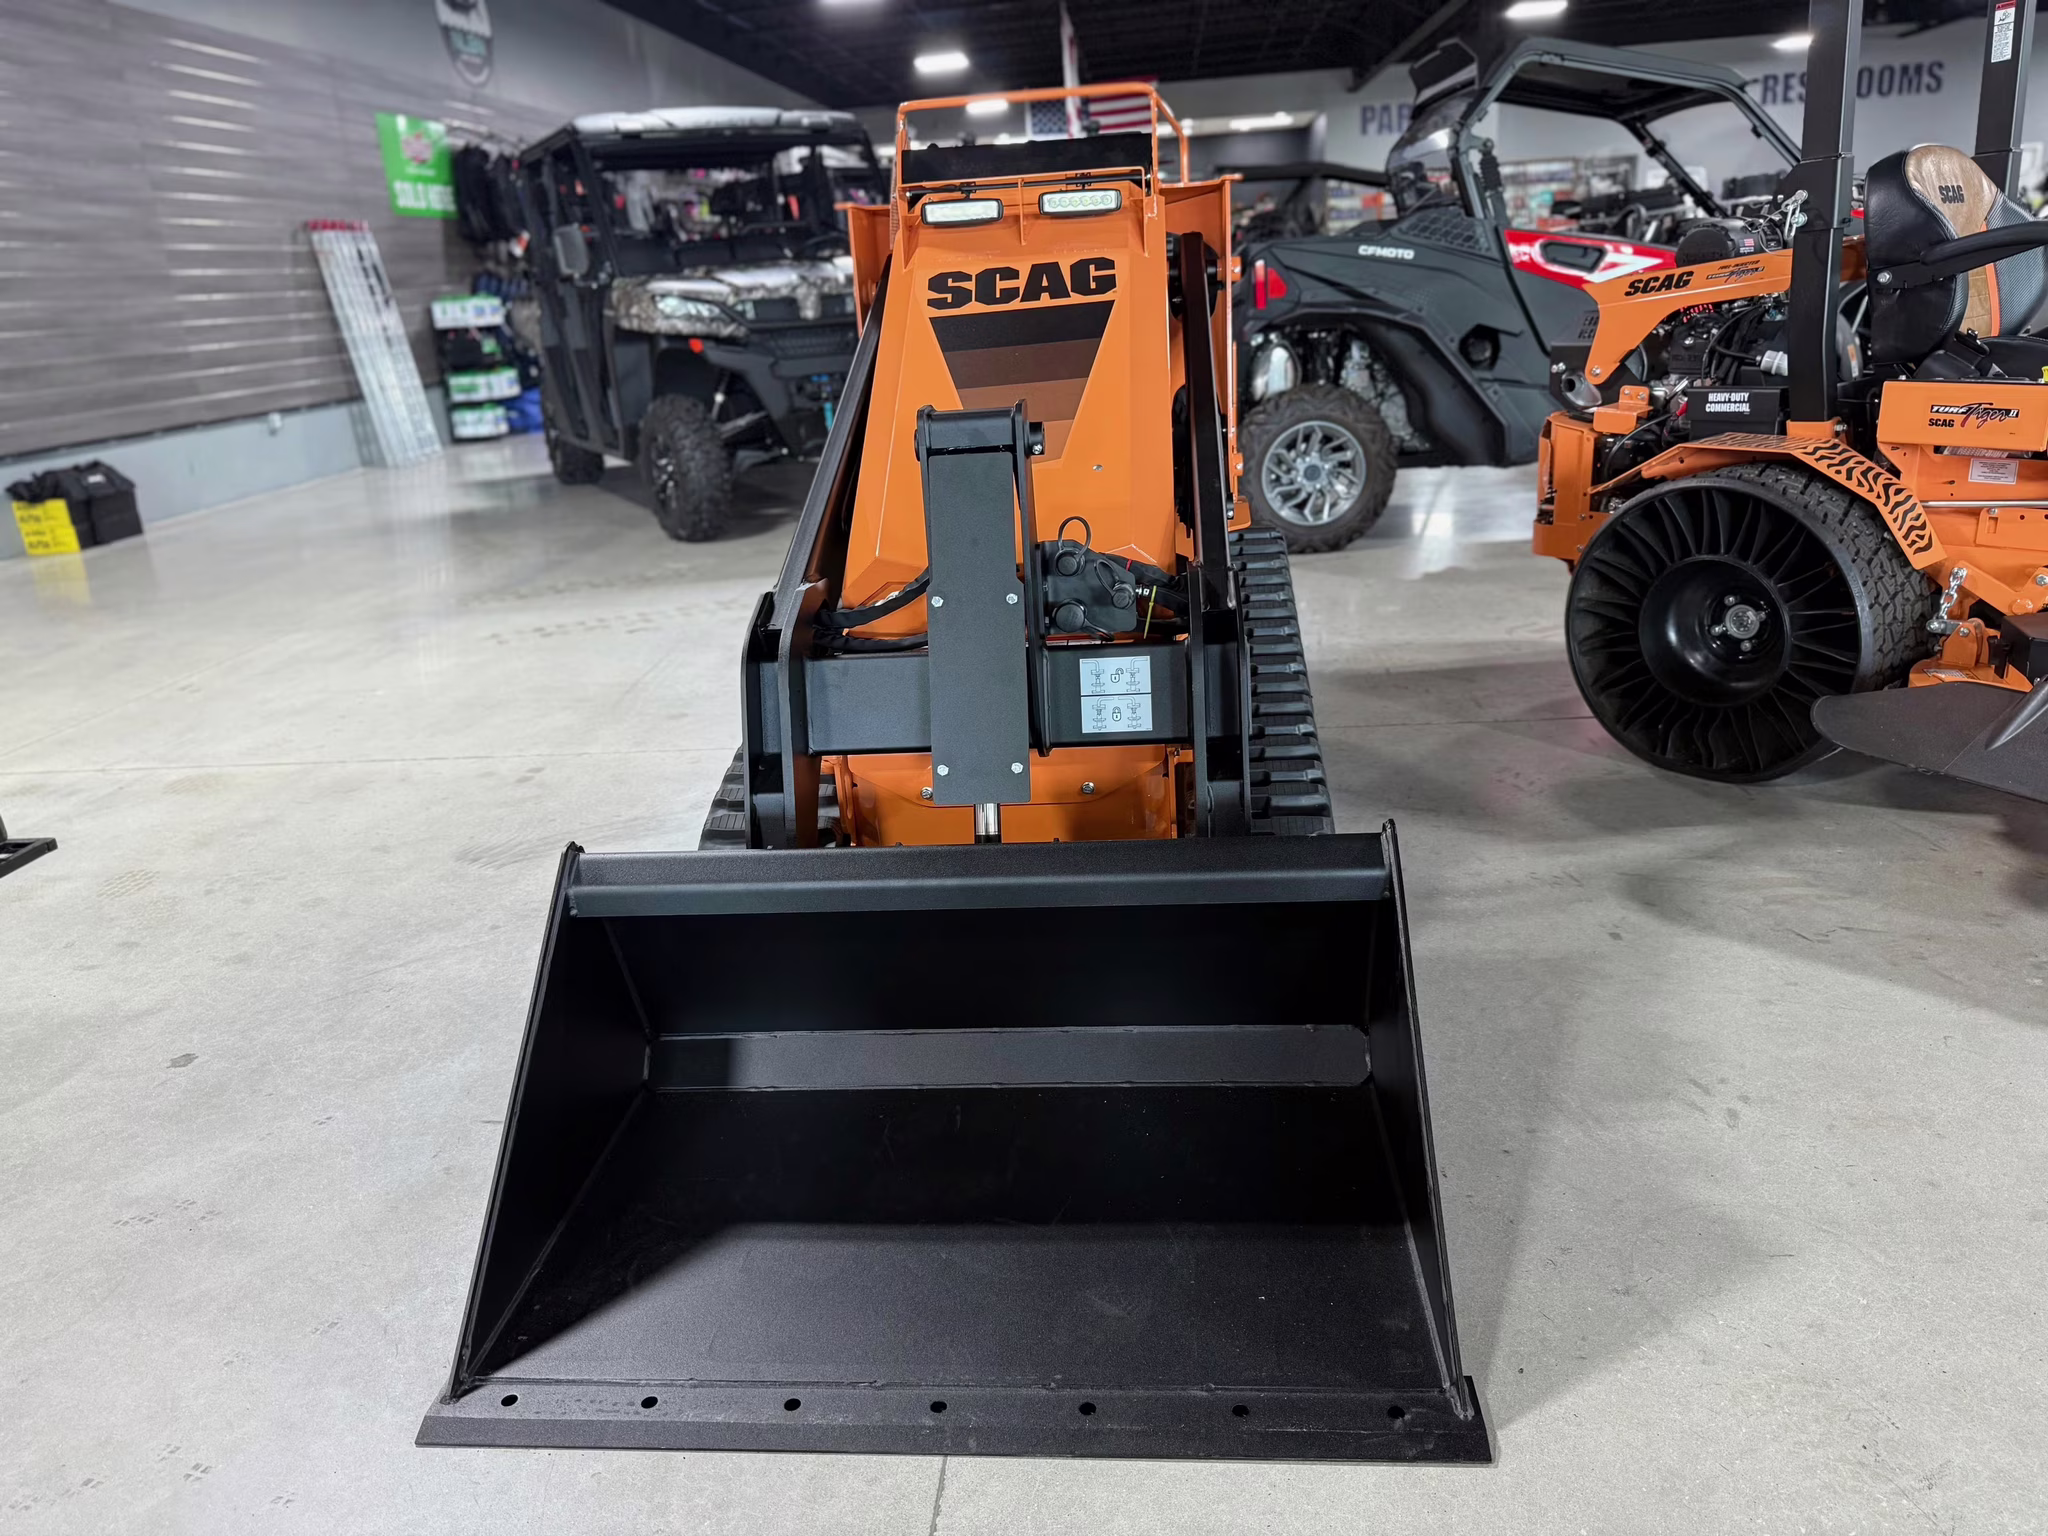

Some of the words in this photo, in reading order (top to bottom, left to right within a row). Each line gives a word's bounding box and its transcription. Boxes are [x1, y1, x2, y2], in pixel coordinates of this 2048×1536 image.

[1762, 60, 1945, 105] REOOMS
[1361, 102, 1412, 135] PAR
[1938, 184, 1965, 204] SCAG
[1358, 244, 1415, 260] CFMOTO
[927, 256, 1117, 310] SCAG
[1624, 271, 1695, 297] SCAG
[1705, 403, 1751, 413] COMMERCIAL
[1708, 392, 1750, 402] HEAVY-DUTY
[1928, 418, 1955, 428] SCAG
[1931, 405, 1969, 414] TURF
[1960, 402, 2007, 429] Tiger
